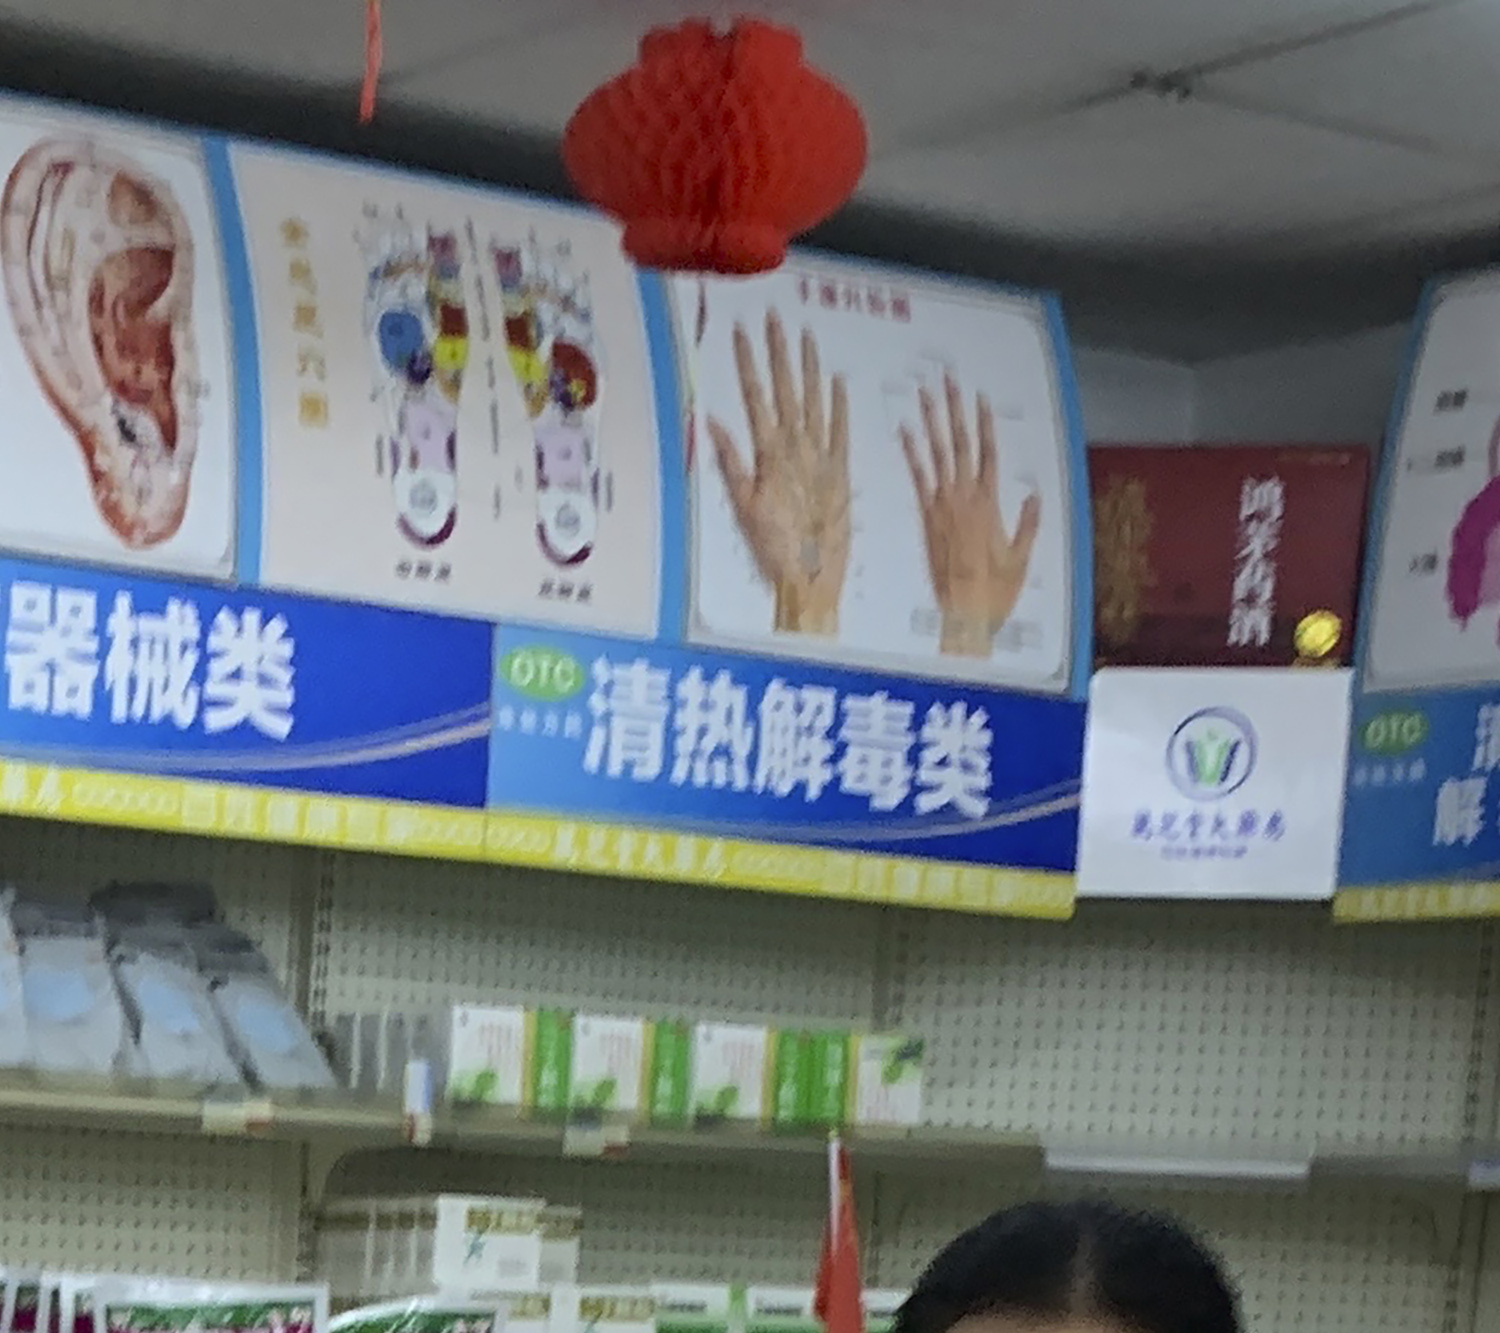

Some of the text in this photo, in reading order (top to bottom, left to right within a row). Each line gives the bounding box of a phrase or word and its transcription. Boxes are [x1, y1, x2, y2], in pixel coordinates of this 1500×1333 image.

[510, 652, 577, 693] OTC
[582, 655, 994, 819] 清热解毒类
